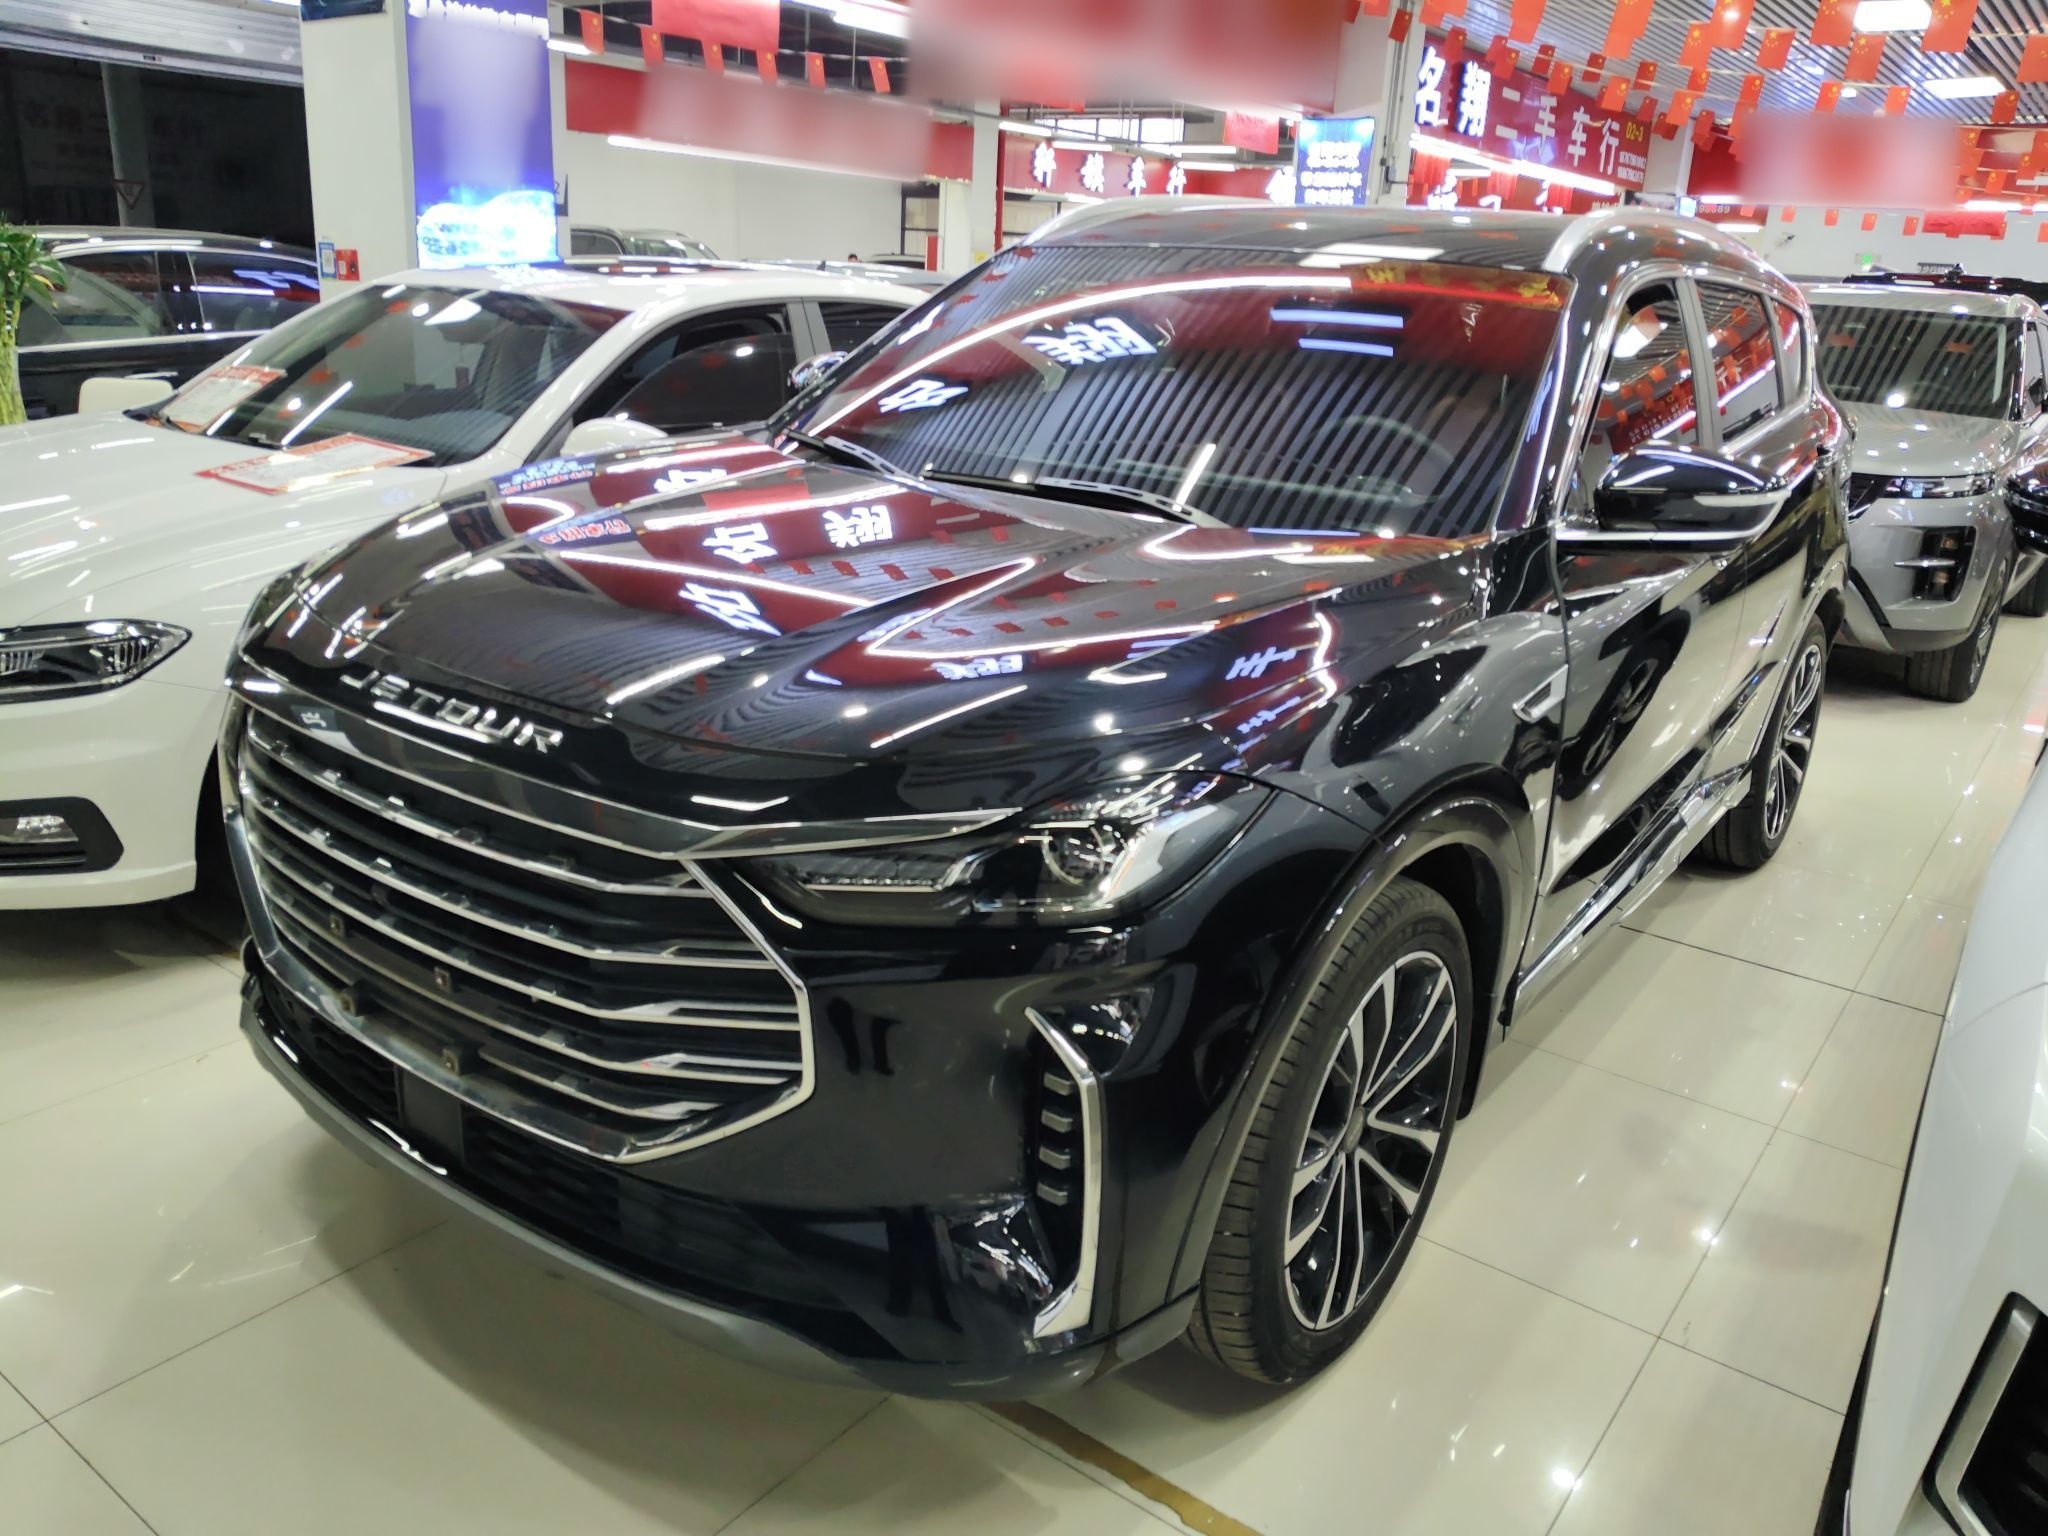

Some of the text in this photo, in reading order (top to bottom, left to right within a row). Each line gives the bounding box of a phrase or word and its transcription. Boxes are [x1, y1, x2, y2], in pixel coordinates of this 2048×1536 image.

[1415, 46, 1620, 175] 名翔二手车行
[339, 669, 564, 754] JETOUR
